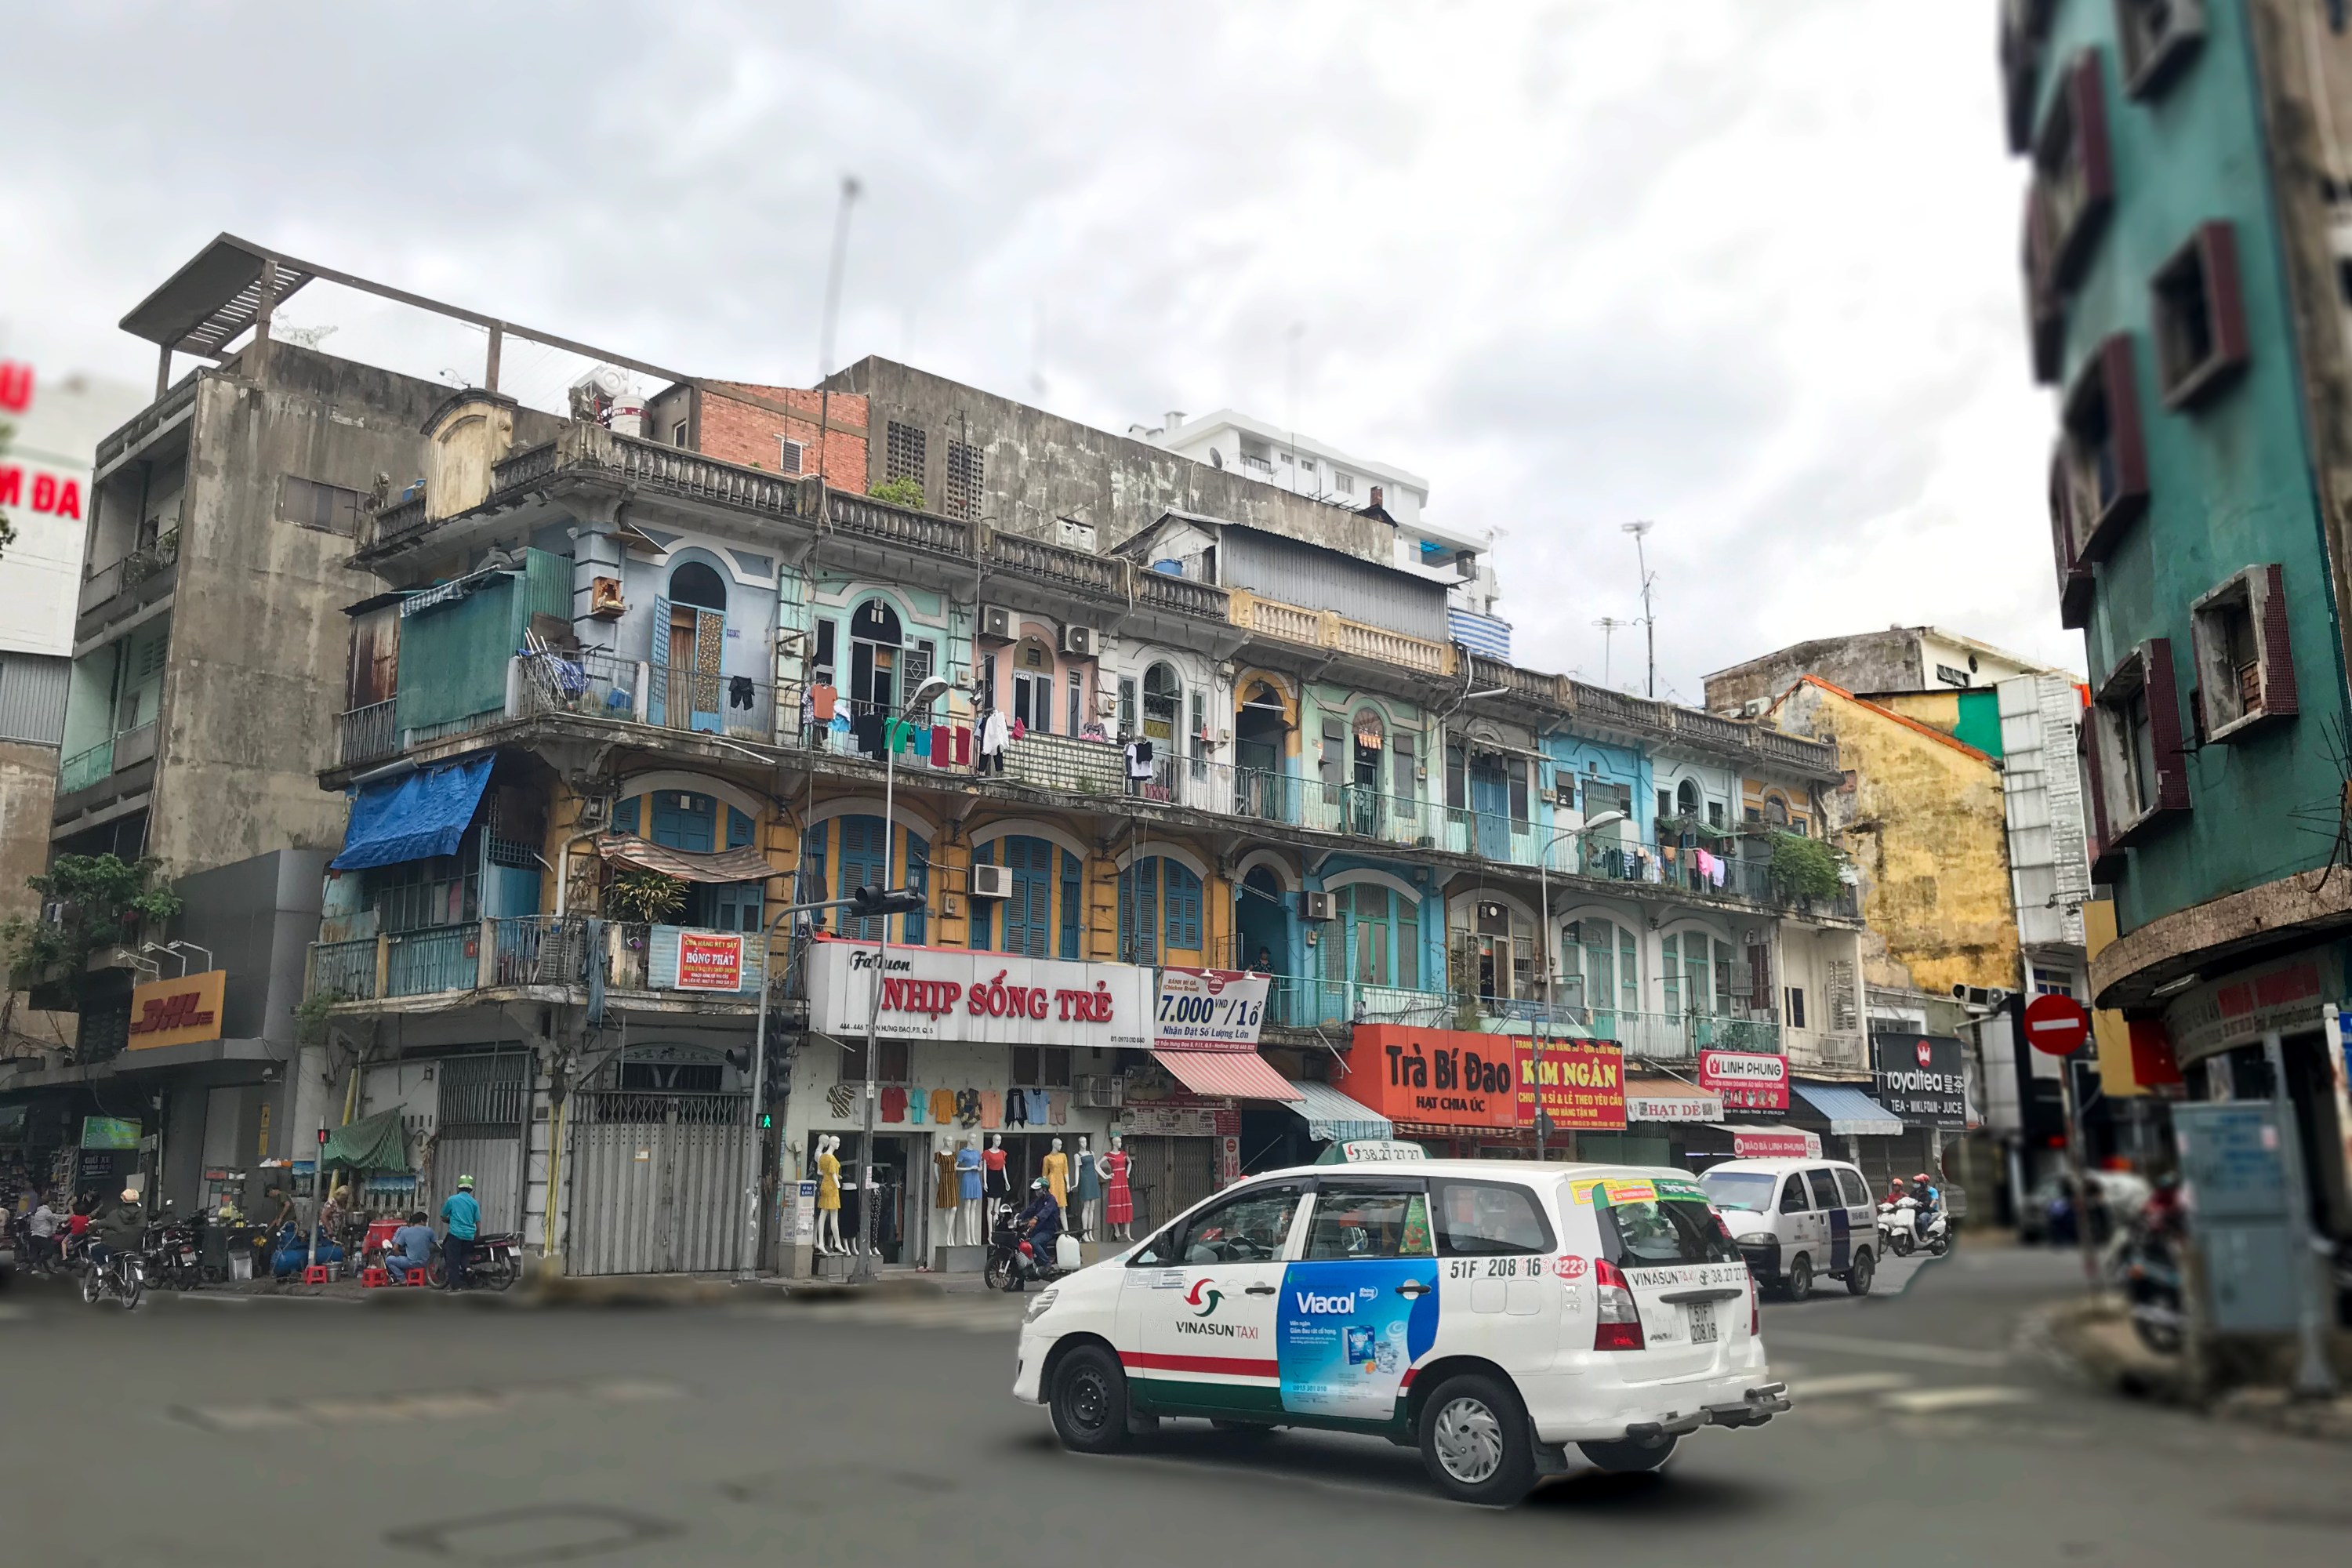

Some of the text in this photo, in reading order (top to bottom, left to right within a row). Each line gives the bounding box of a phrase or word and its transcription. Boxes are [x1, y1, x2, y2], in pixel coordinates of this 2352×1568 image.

[686, 948, 735, 965] HỒNG PHÁT
[881, 969, 1114, 1022] NHỊP SỐNG TRẺ
[140, 992, 201, 1032] DHL
[1160, 995, 1214, 1024] 7.000
[1163, 1025, 1249, 1039] Nhận Đặt Số Lượng Lớn
[1386, 1044, 1511, 1094] Trà Bí Đao
[1562, 1057, 1617, 1088] NGÂN
[1722, 1060, 1744, 1074] LINH
[1887, 1069, 1943, 1094] royaltea
[1944, 1074, 1964, 1094] 皇茶
[1416, 1096, 1486, 1112] HẠT CHIA ÚC
[1518, 1092, 1547, 1104] CHUYN
[1574, 1094, 1593, 1105] THEO
[1595, 1093, 1606, 1105] YÊU
[1609, 1092, 1623, 1106] CẦU
[1891, 1099, 1906, 1112] TEA
[1943, 1102, 1962, 1114] JUICE
[1649, 1100, 1701, 1119] HẠT DẺ
[1769, 1142, 1783, 1151] LINH
[1807, 1140, 1820, 1149] 432
[1450, 1258, 1541, 1279] 51F 208 16
[1632, 1271, 1679, 1287] VINASUN
[1296, 1292, 1355, 1314] Viacol
[1694, 1305, 1708, 1323] 51F
[1176, 1321, 1234, 1337] VINASUN
